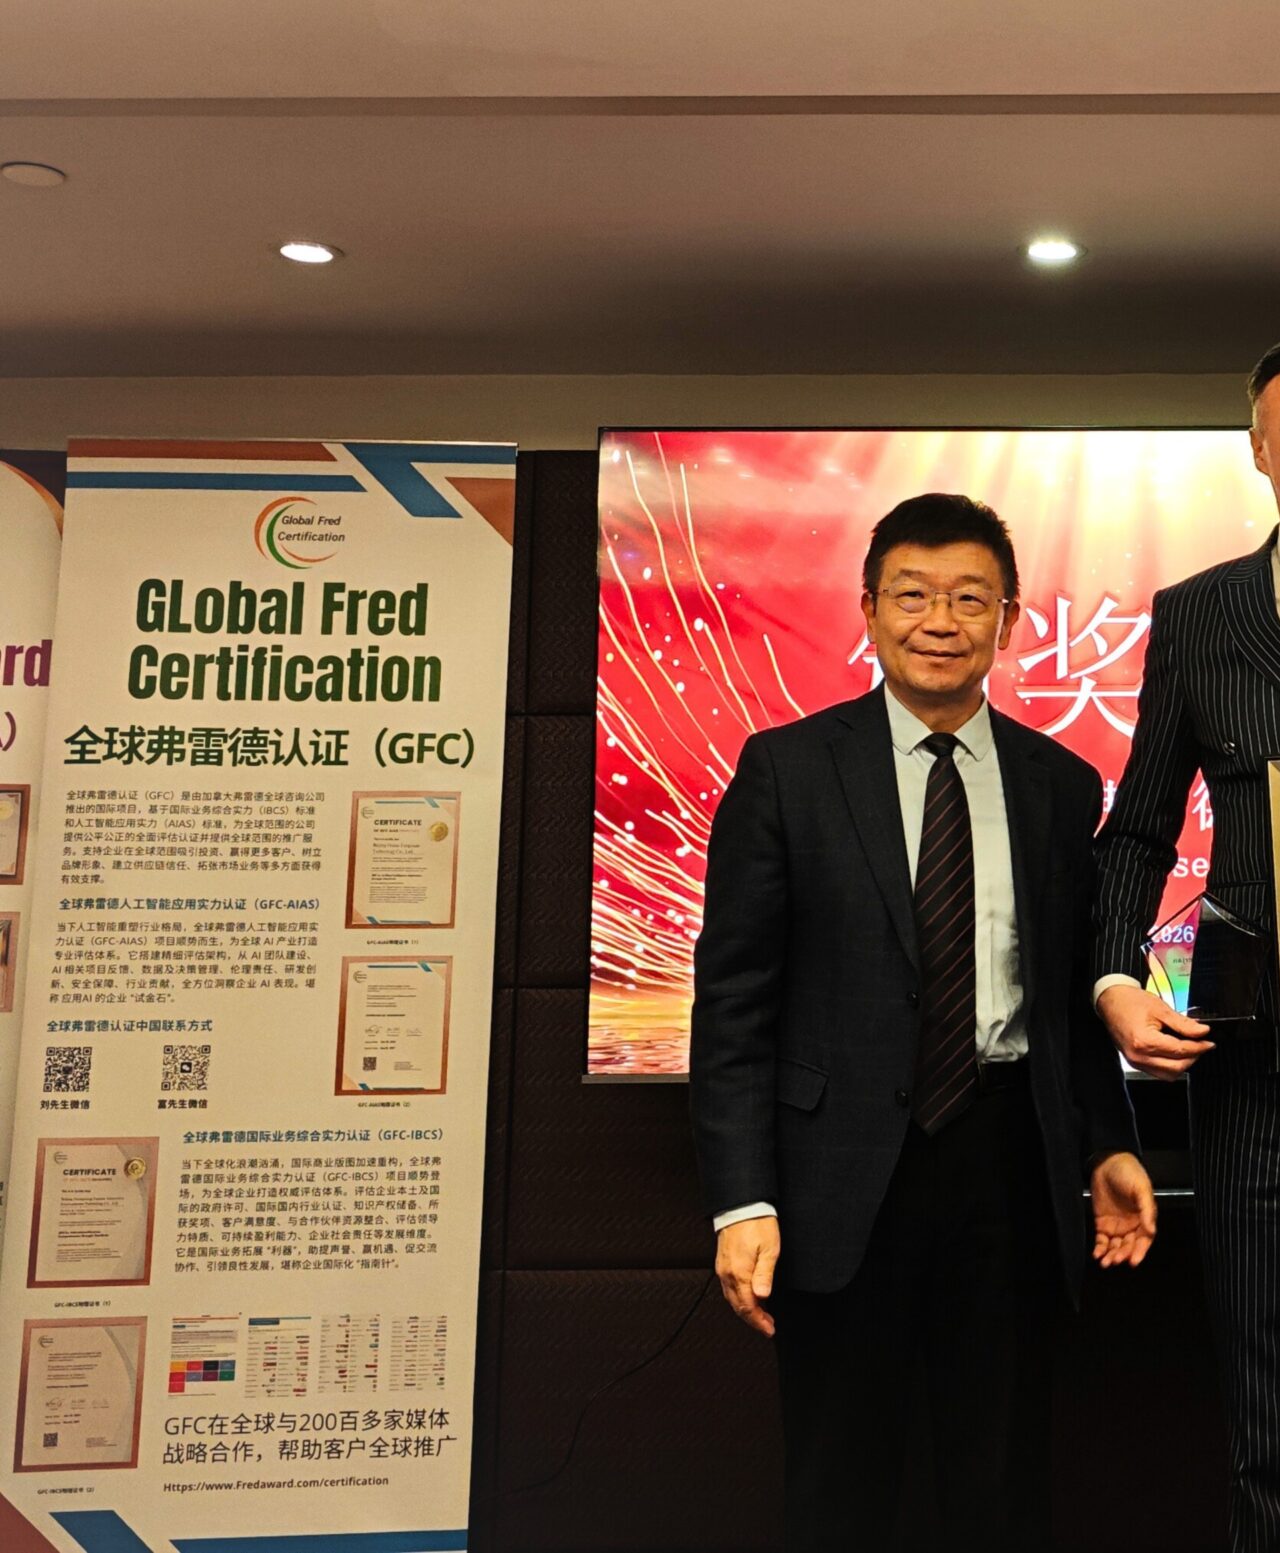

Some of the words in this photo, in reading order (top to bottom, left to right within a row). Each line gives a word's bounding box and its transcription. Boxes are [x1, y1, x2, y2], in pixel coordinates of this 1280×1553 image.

[281, 515, 314, 527] Global
[318, 515, 342, 526] Fred
[277, 531, 346, 543] Certification
[136, 579, 305, 635] GLobal
[320, 582, 429, 636] Fred
[0, 639, 53, 687] rd
[128, 645, 442, 702] Certification
[64, 725, 475, 769] 全球弗雷德认证（GFC）
[47, 1020, 213, 1032] 全球弗雷德认证中国联系方式
[40, 1100, 90, 1110] 刘先生微信
[63, 1168, 117, 1176] CERTIFICATE
[164, 1408, 449, 1435] GFC在全球与200百多家媒体
[162, 1435, 457, 1464] 战略合作，帮助客户全球推广
[164, 1476, 389, 1493] Https://www.Fredaward.com/certification
